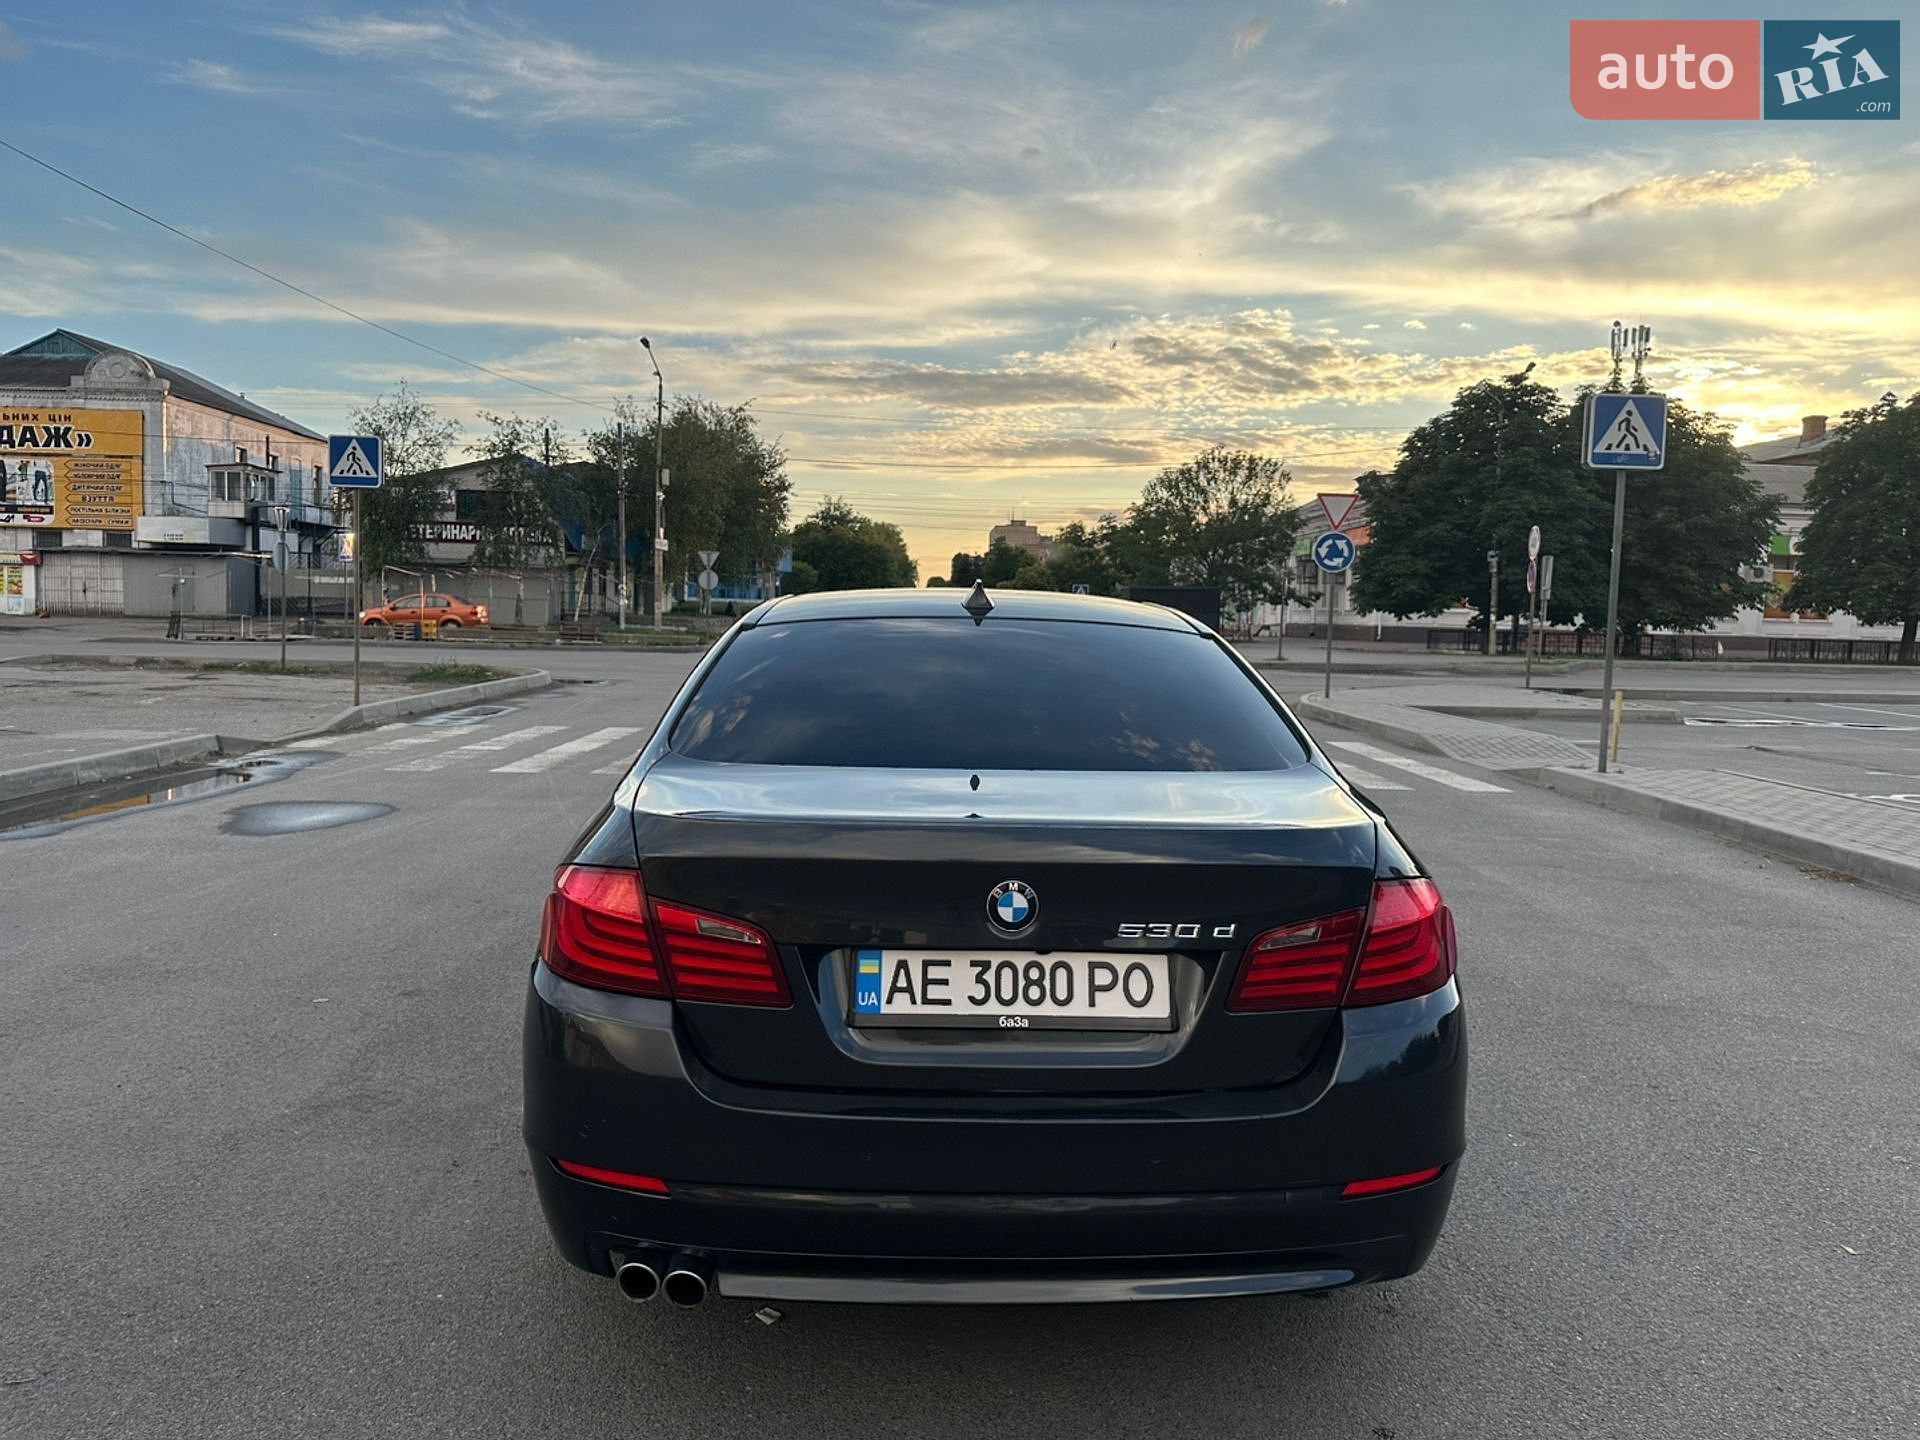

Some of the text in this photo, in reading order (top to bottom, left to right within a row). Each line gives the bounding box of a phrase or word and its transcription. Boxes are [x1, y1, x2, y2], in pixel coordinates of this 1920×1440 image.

[48, 414, 72, 422] ЦІН
[992, 882, 1034, 899] BMW
[1118, 923, 1201, 938] 530
[885, 959, 1154, 1008] AE 3080 PO
[858, 991, 879, 1006] UA
